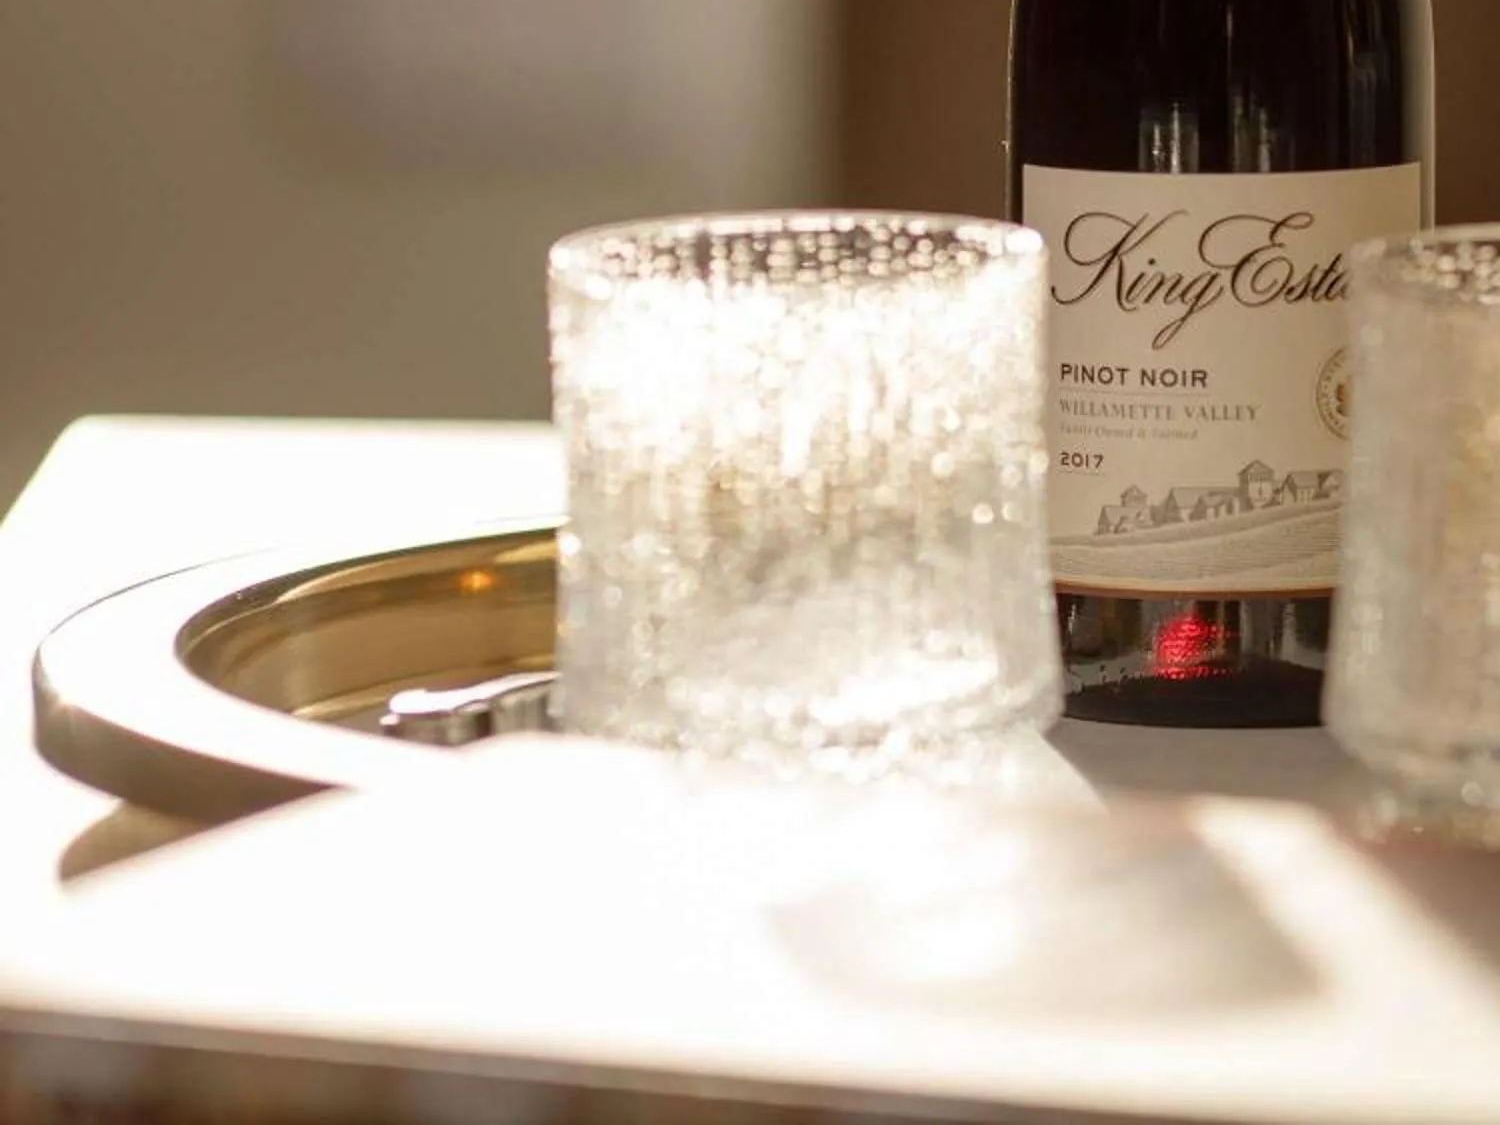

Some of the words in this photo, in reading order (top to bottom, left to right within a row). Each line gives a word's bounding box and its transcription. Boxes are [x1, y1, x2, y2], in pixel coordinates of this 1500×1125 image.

[1050, 209, 1225, 350] King
[1198, 211, 1350, 308] Esta
[1060, 363, 1130, 386] PINOT
[1140, 369, 1209, 388] NOIR
[1059, 398, 1174, 420] WILLAMETTE
[1184, 404, 1261, 422] VALLEY
[1060, 451, 1104, 469] 2017
